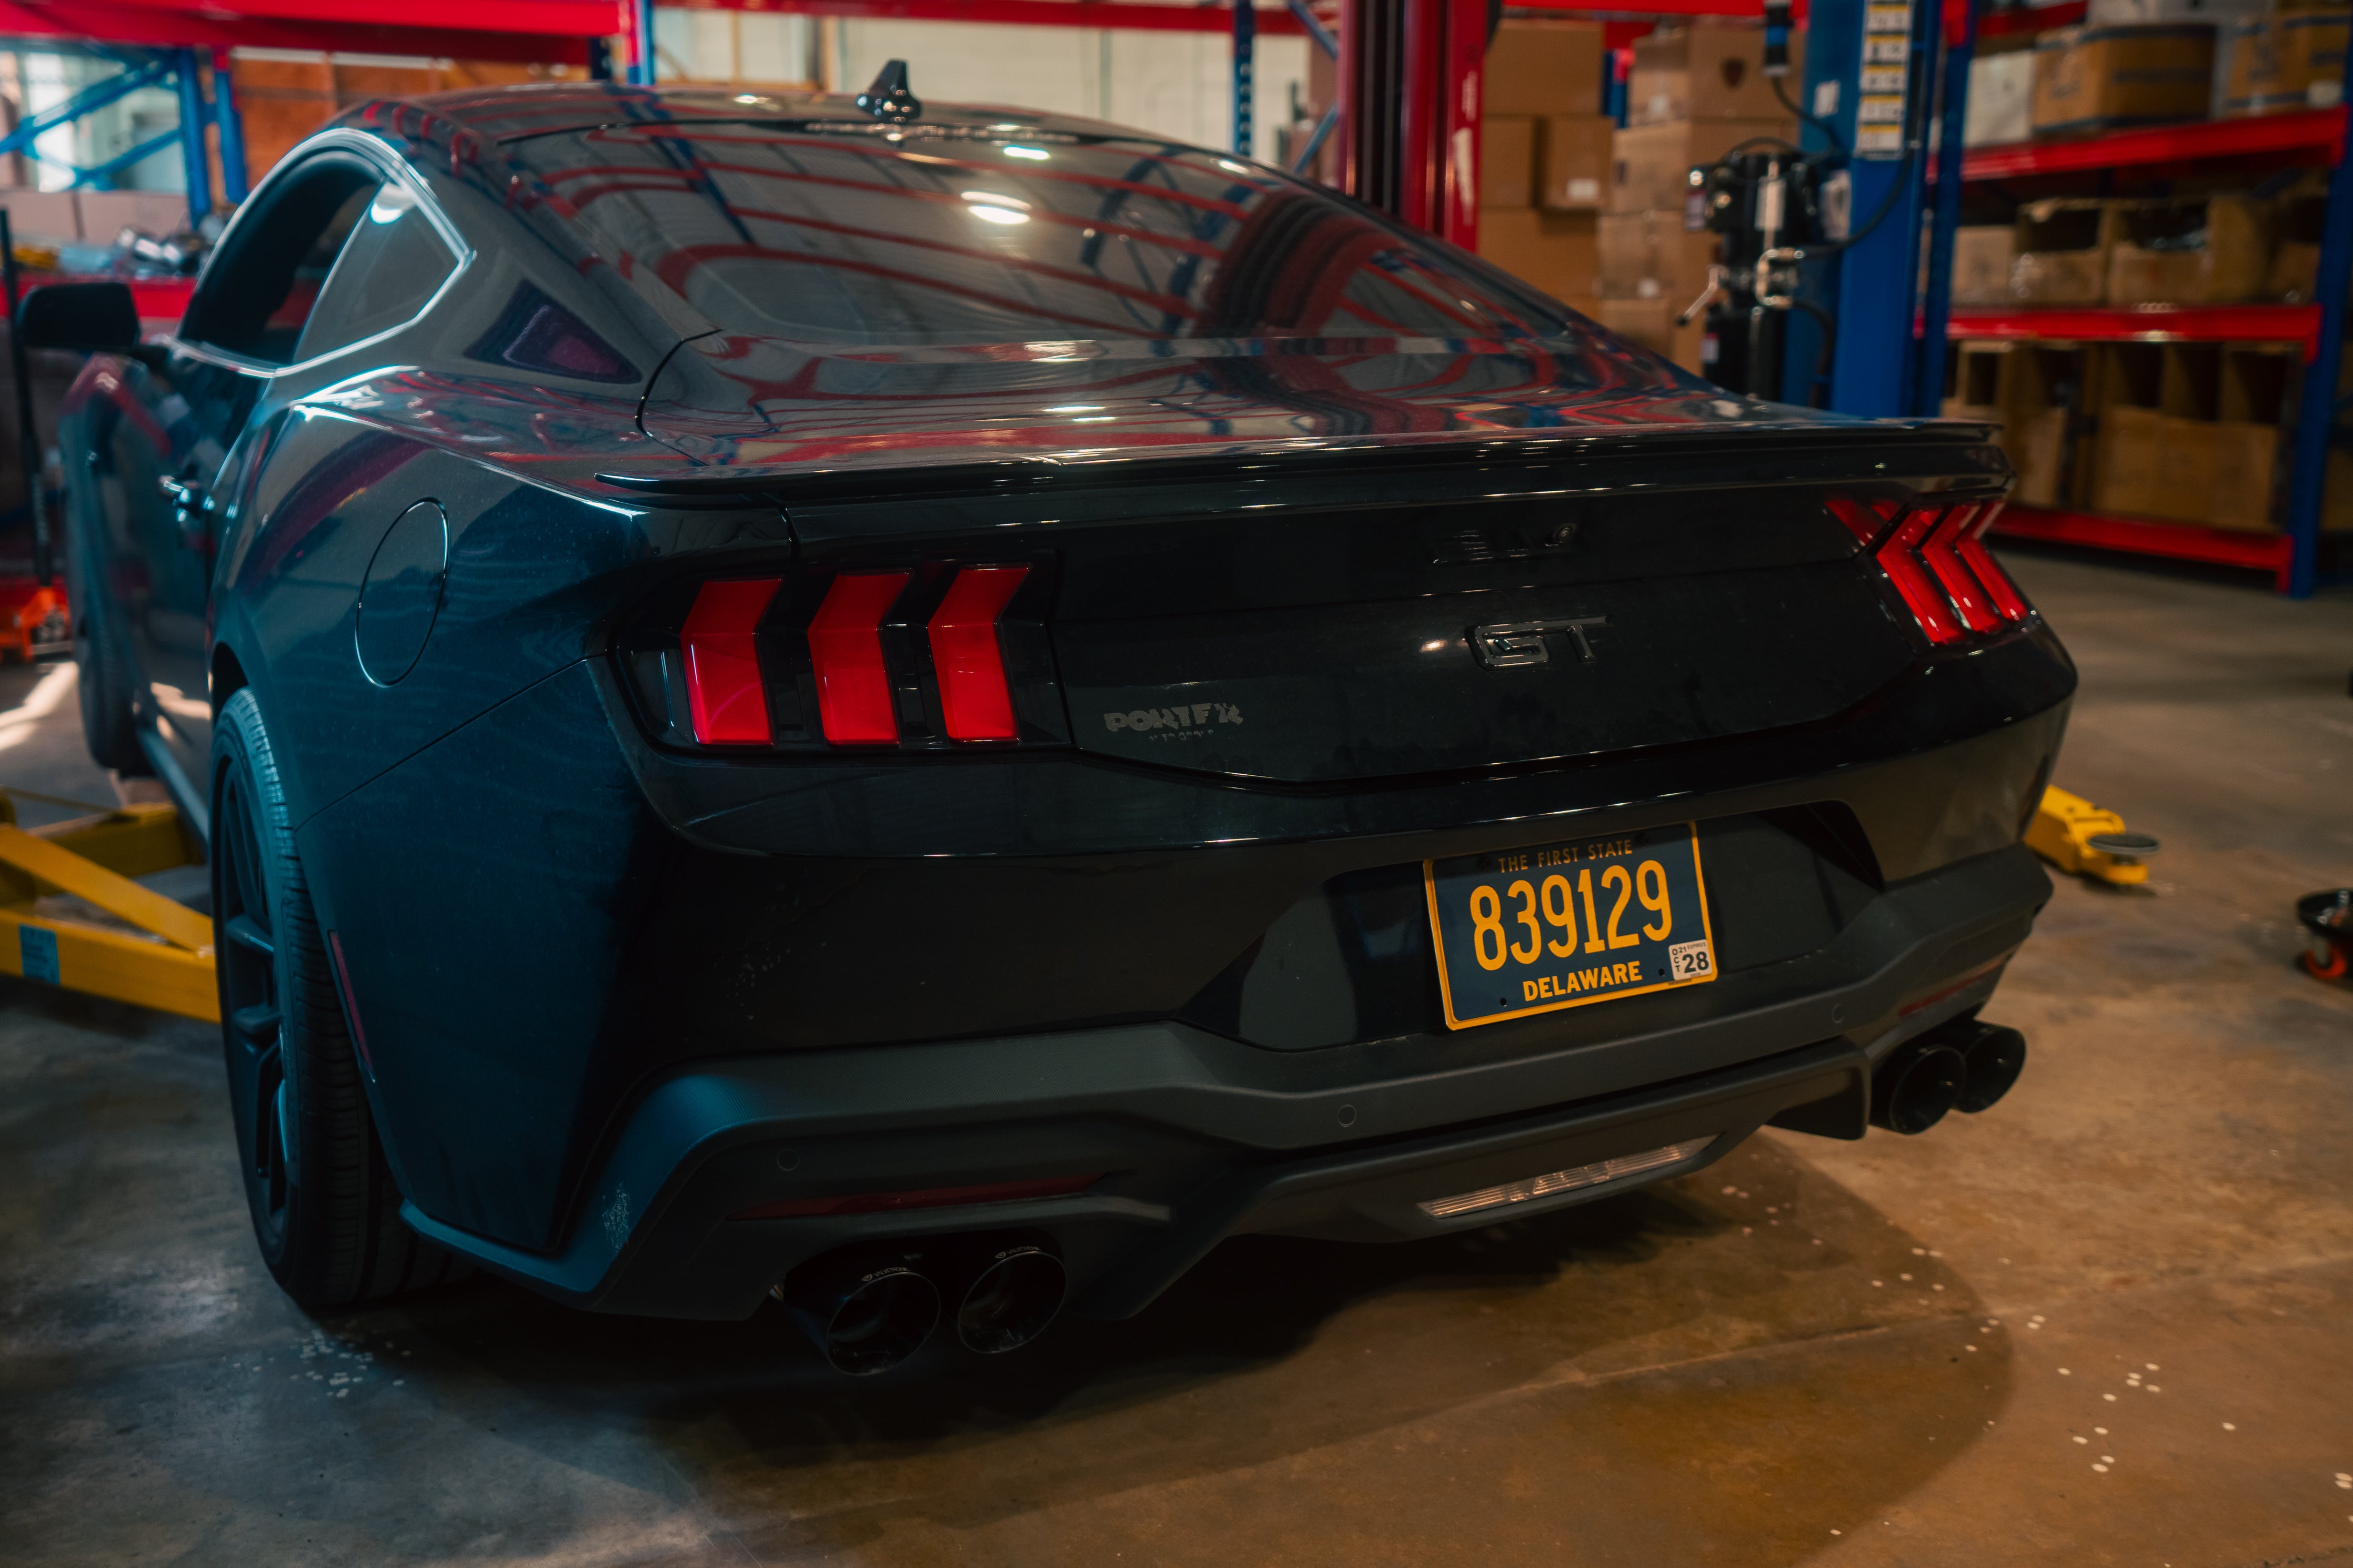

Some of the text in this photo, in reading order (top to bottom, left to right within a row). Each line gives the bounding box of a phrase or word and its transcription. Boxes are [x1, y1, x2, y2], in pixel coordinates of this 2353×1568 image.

[1465, 615, 1610, 671] GT
[1499, 839, 1633, 873] THE FIRST STATE
[1470, 859, 1672, 971] 839129
[1672, 948, 1681, 972] OCT
[1682, 951, 1709, 973] 28
[1523, 960, 1643, 1002] DELAWARE
